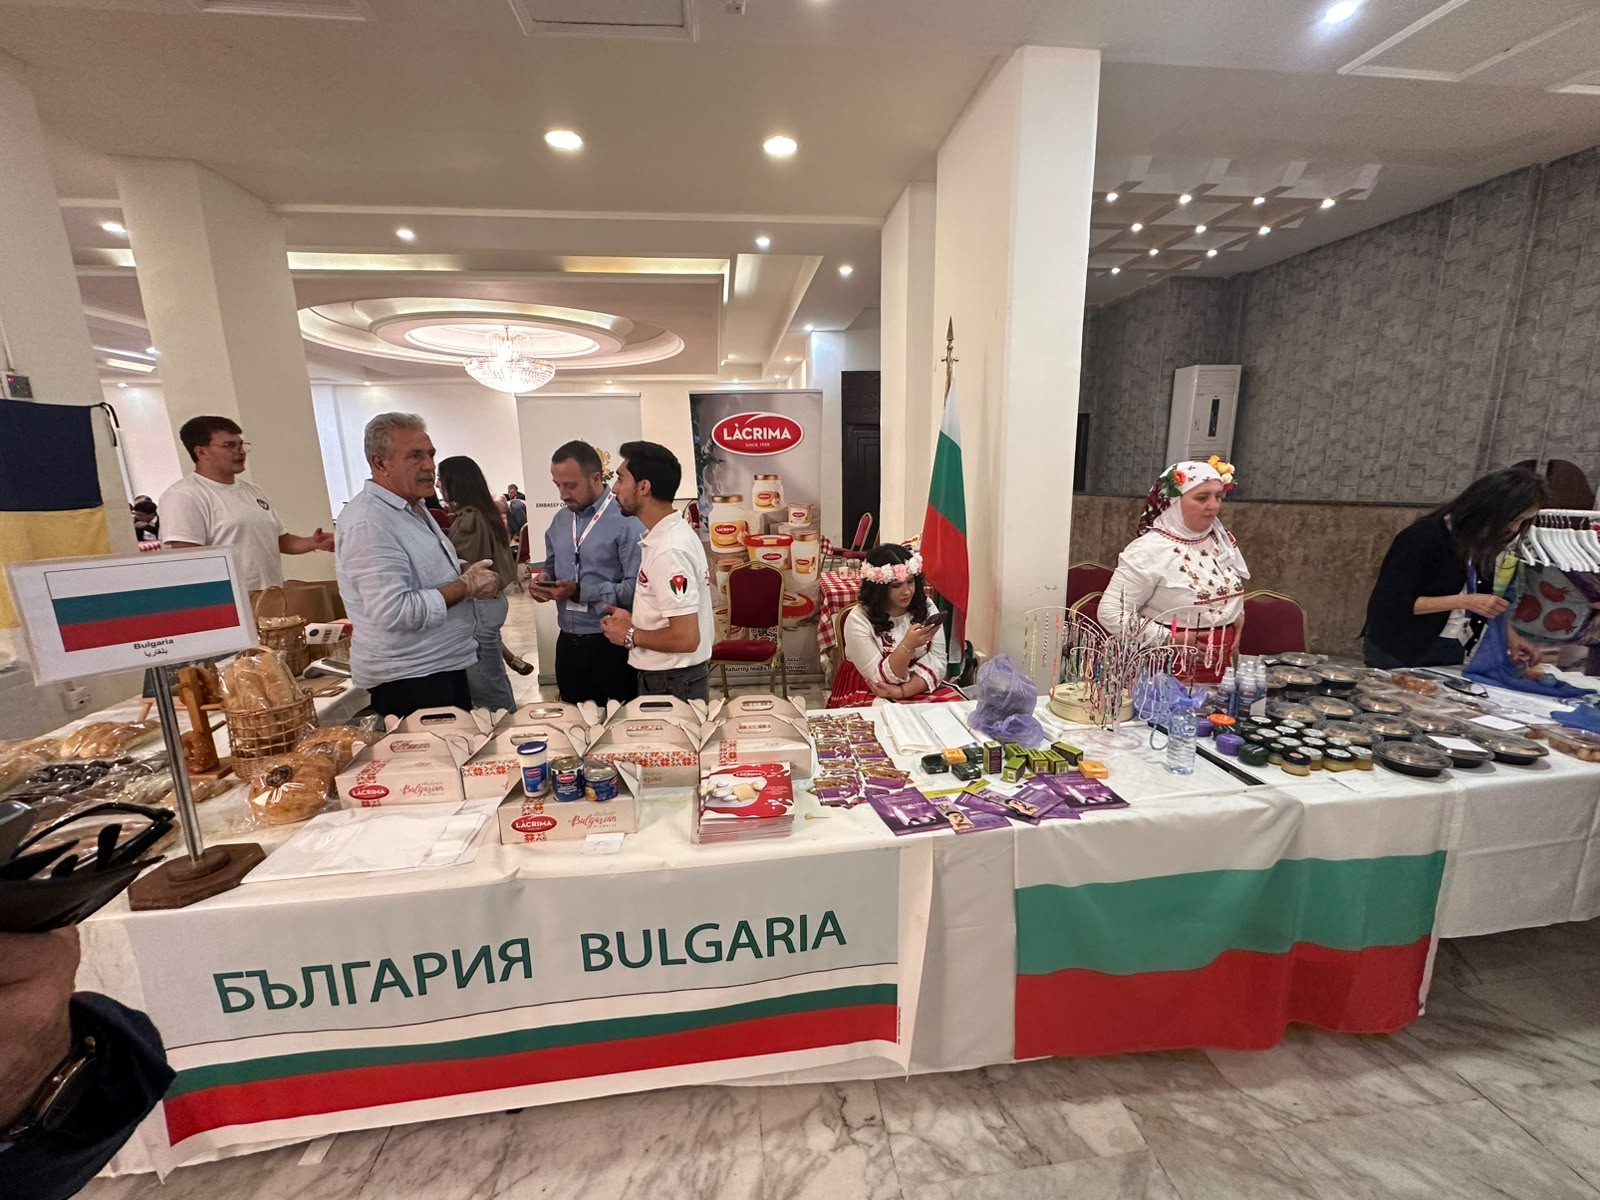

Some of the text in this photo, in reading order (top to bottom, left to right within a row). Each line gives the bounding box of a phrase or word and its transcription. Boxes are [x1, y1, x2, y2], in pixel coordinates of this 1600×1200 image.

[722, 423, 792, 441] LÀCRIMA
[133, 639, 174, 650] Bulgaria
[143, 648, 169, 657] بلغاريا
[568, 814, 617, 829] Bulgarian
[213, 910, 848, 1014] БЪЛГАРИЯ BULGARIA
